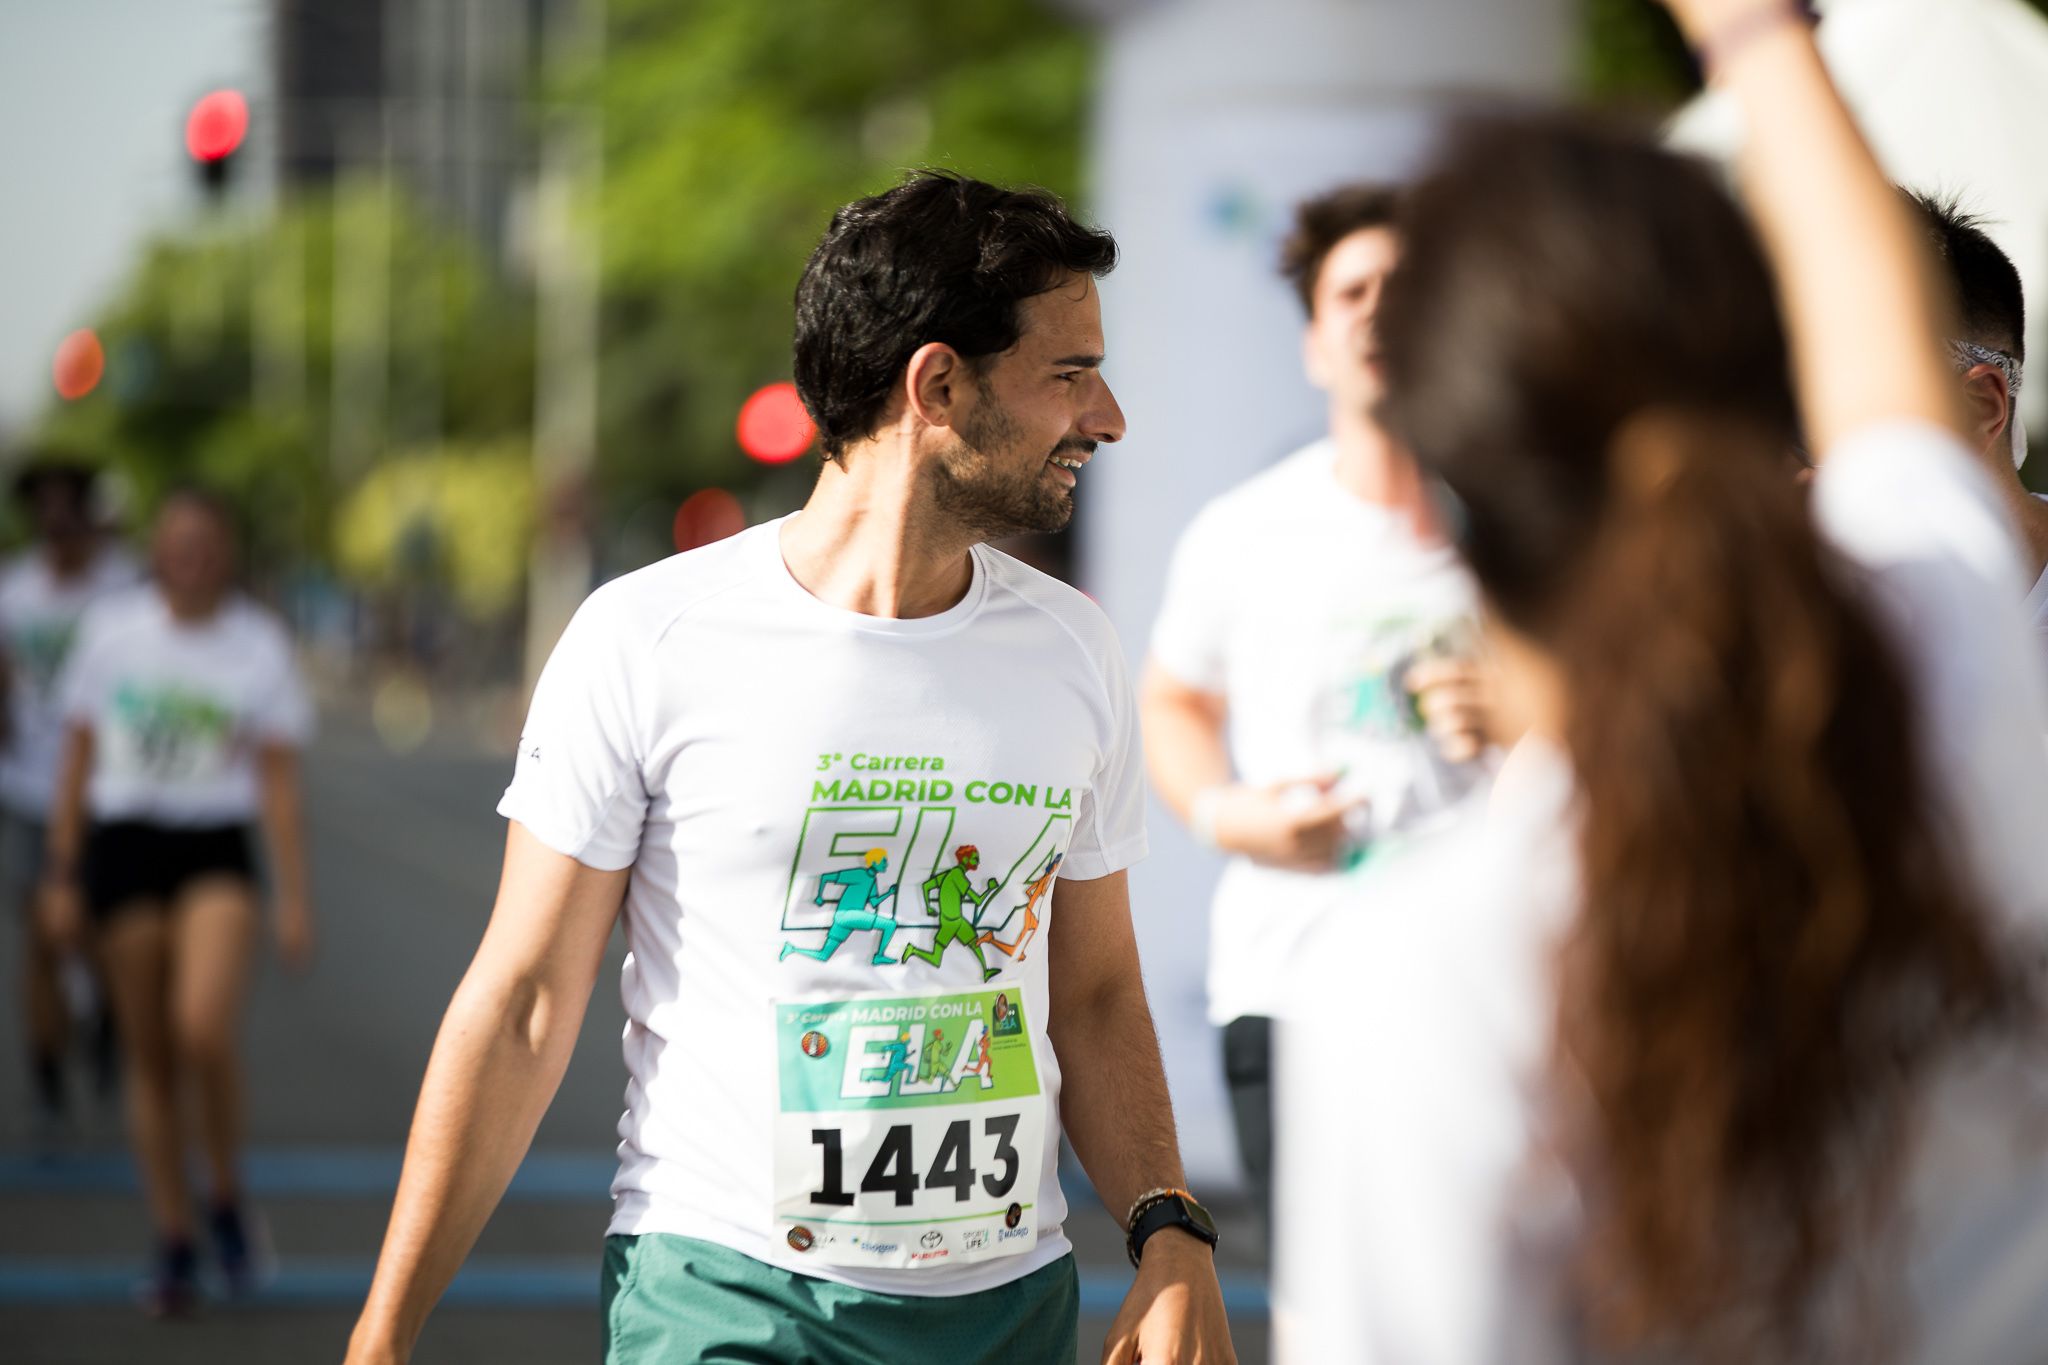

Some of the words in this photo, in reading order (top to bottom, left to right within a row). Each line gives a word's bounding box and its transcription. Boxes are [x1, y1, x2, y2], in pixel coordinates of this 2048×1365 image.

[850, 753, 945, 771] Carrera
[811, 779, 954, 803] MADRID
[964, 781, 1037, 807] CON
[1044, 786, 1071, 809] LA
[851, 1005, 927, 1024] MADRID
[929, 1003, 963, 1020] CON
[965, 1001, 983, 1017] LA
[840, 1018, 994, 1100] ELA
[810, 1113, 1021, 1208] 1443
[965, 1239, 983, 1250] LIFE
